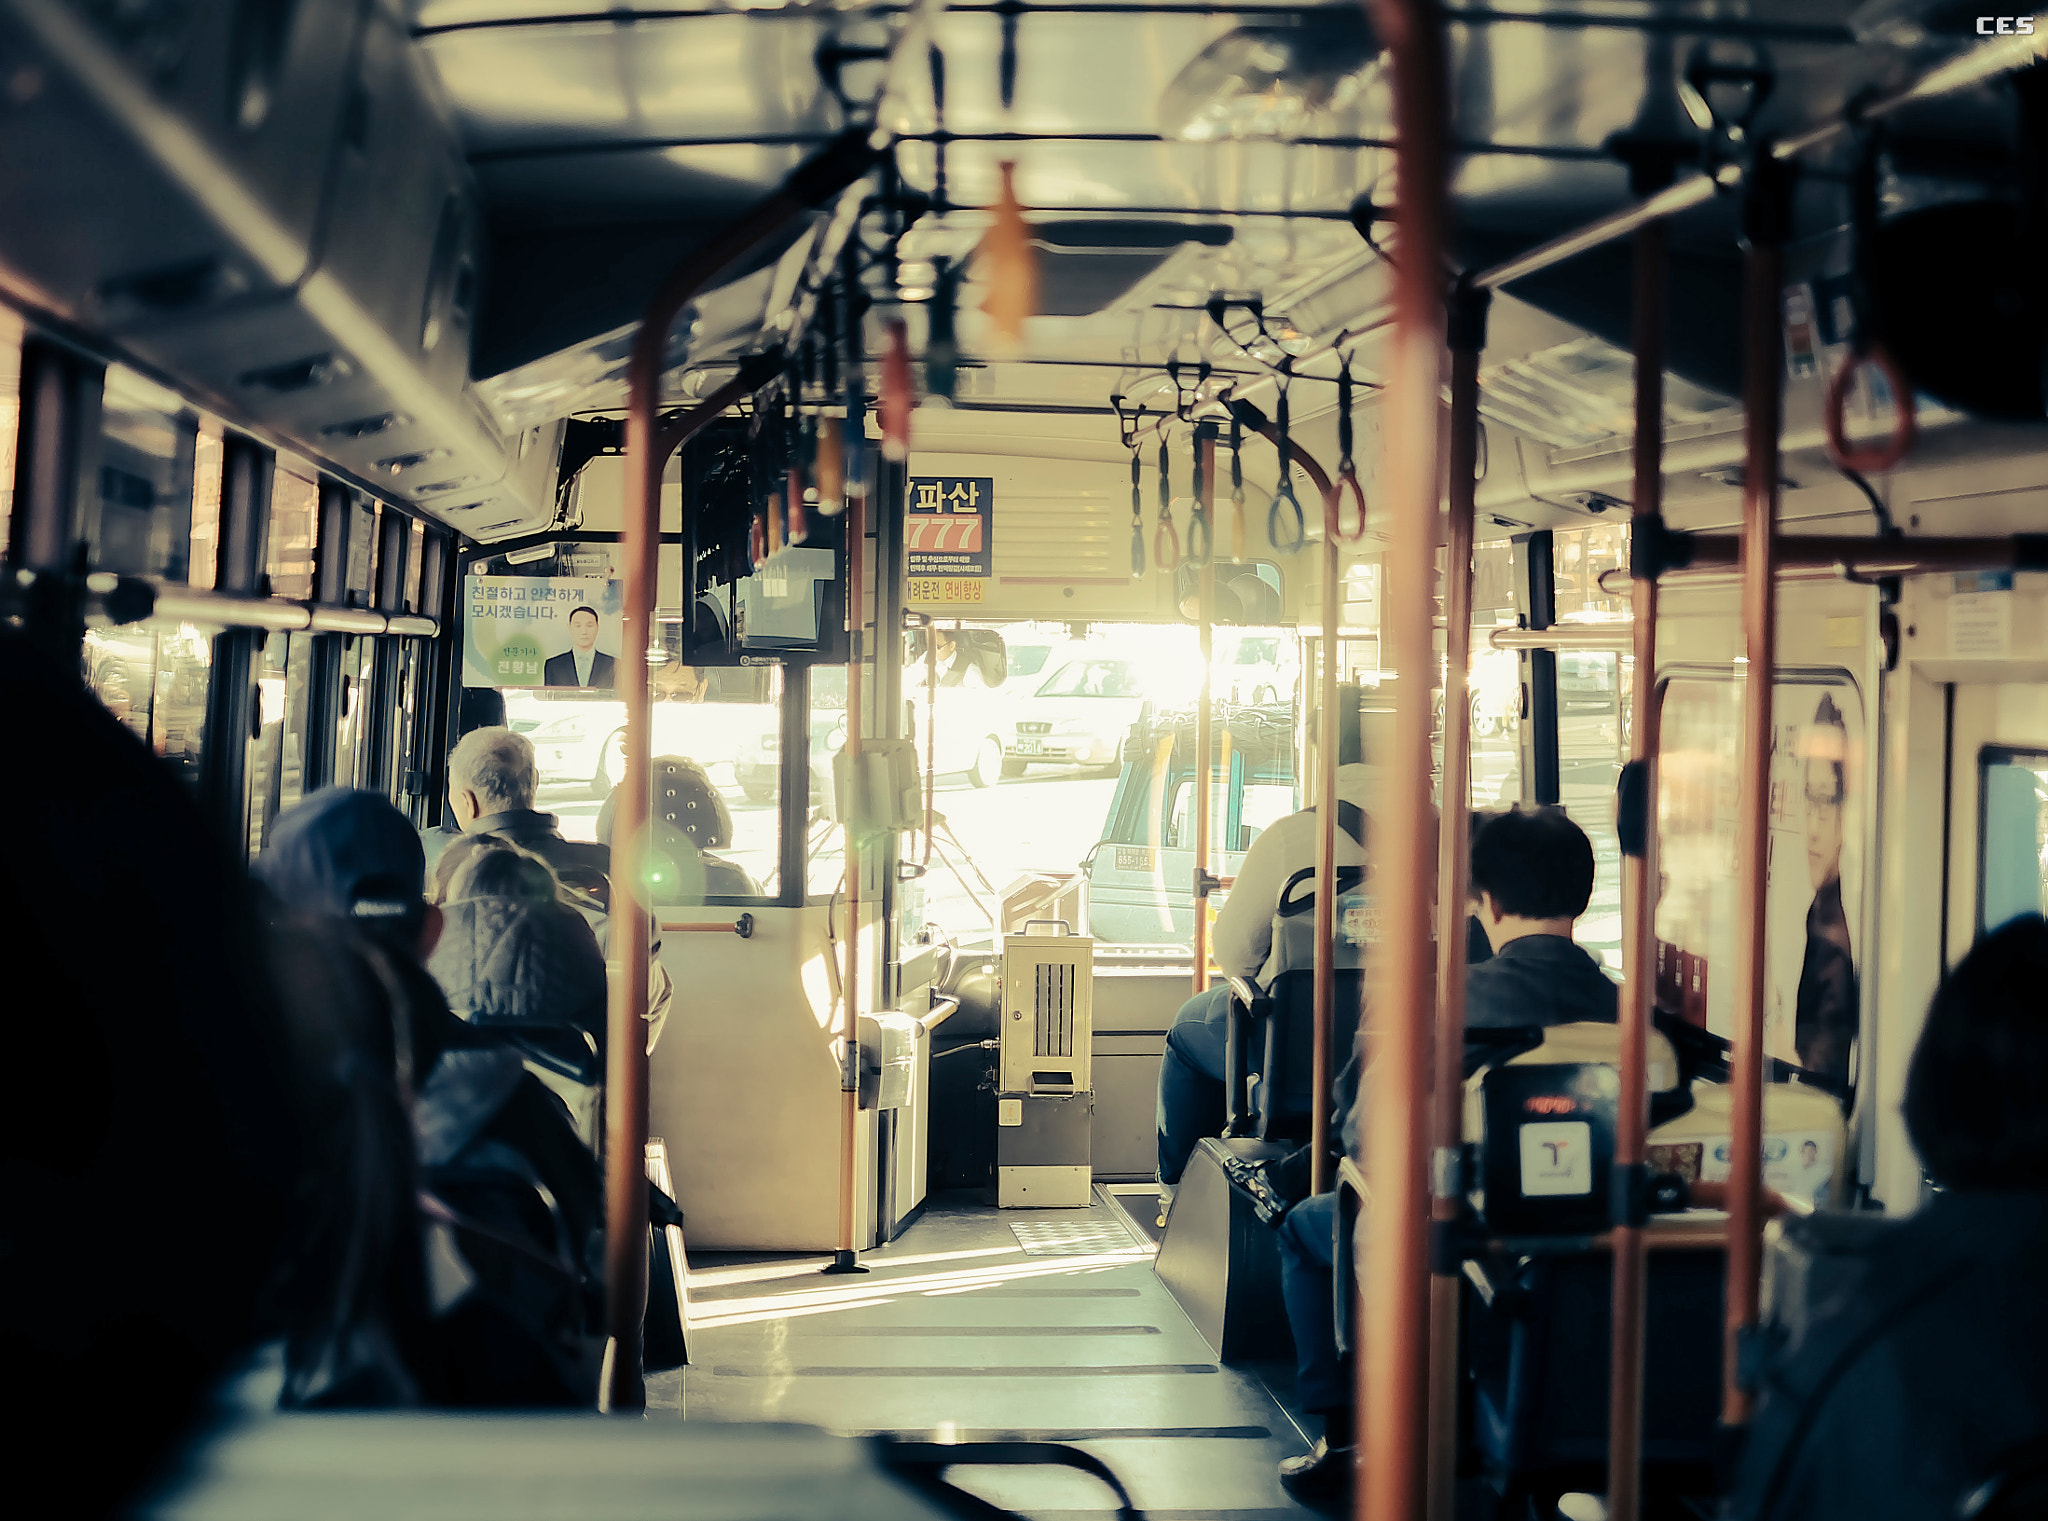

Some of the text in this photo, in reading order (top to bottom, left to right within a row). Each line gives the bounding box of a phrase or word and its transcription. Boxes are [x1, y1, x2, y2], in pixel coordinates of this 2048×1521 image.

[472, 585, 585, 602] 친절하고 안전하게
[945, 580, 982, 601] 연비향상
[471, 604, 558, 620] 모시겠습니다.
